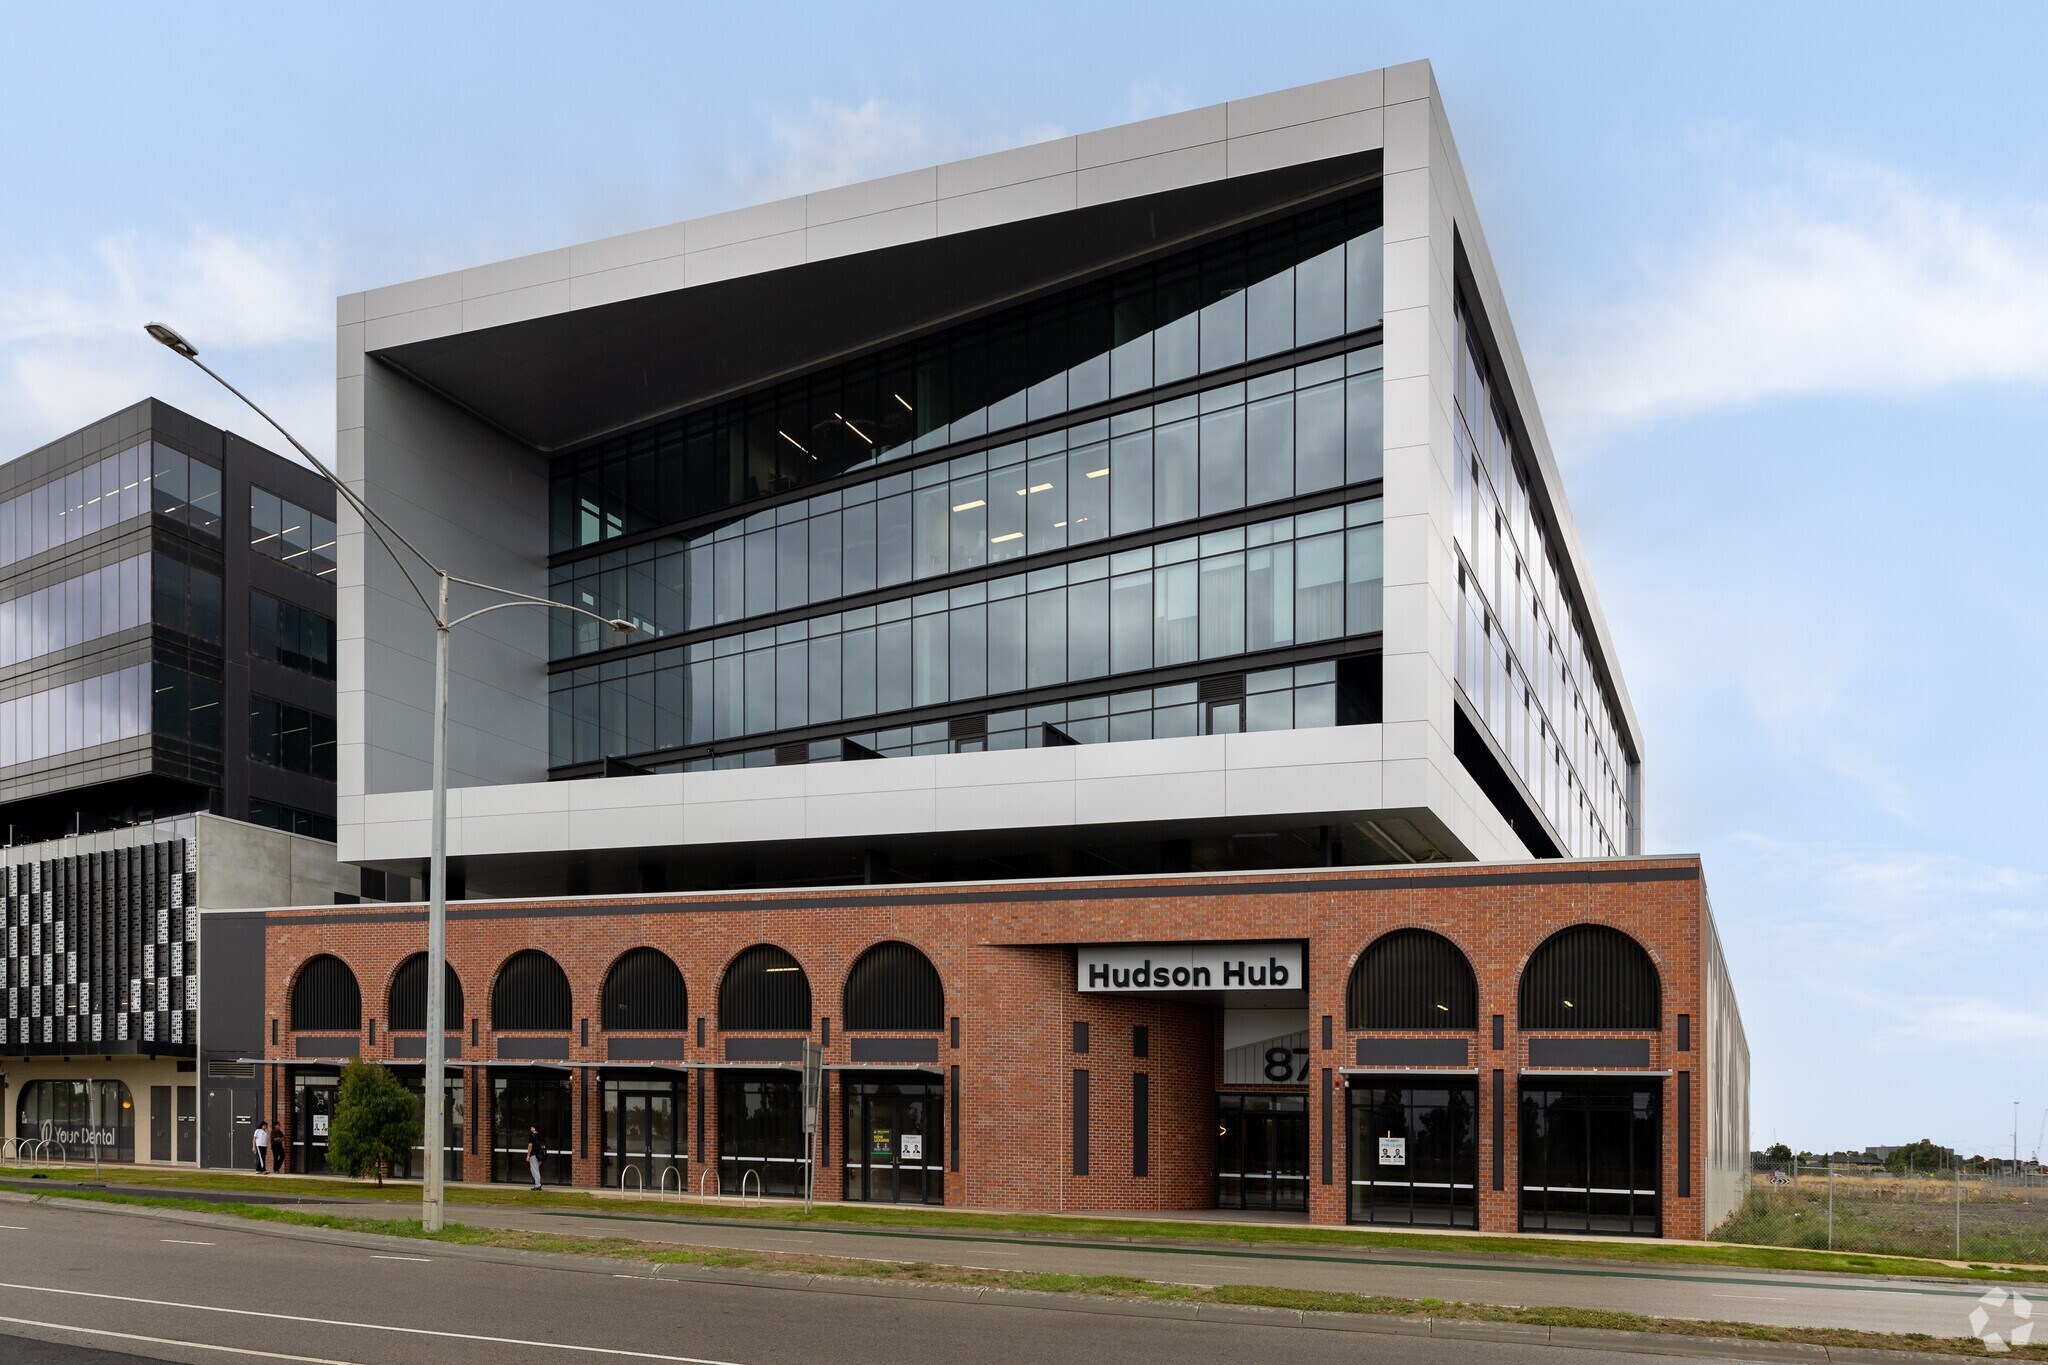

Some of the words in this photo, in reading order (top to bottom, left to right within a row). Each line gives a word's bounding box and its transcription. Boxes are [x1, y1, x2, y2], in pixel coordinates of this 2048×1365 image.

[1089, 960, 1211, 988] Hudson
[1223, 957, 1290, 986] Hub
[54, 1126, 80, 1144] Your
[81, 1127, 115, 1146] Dental
